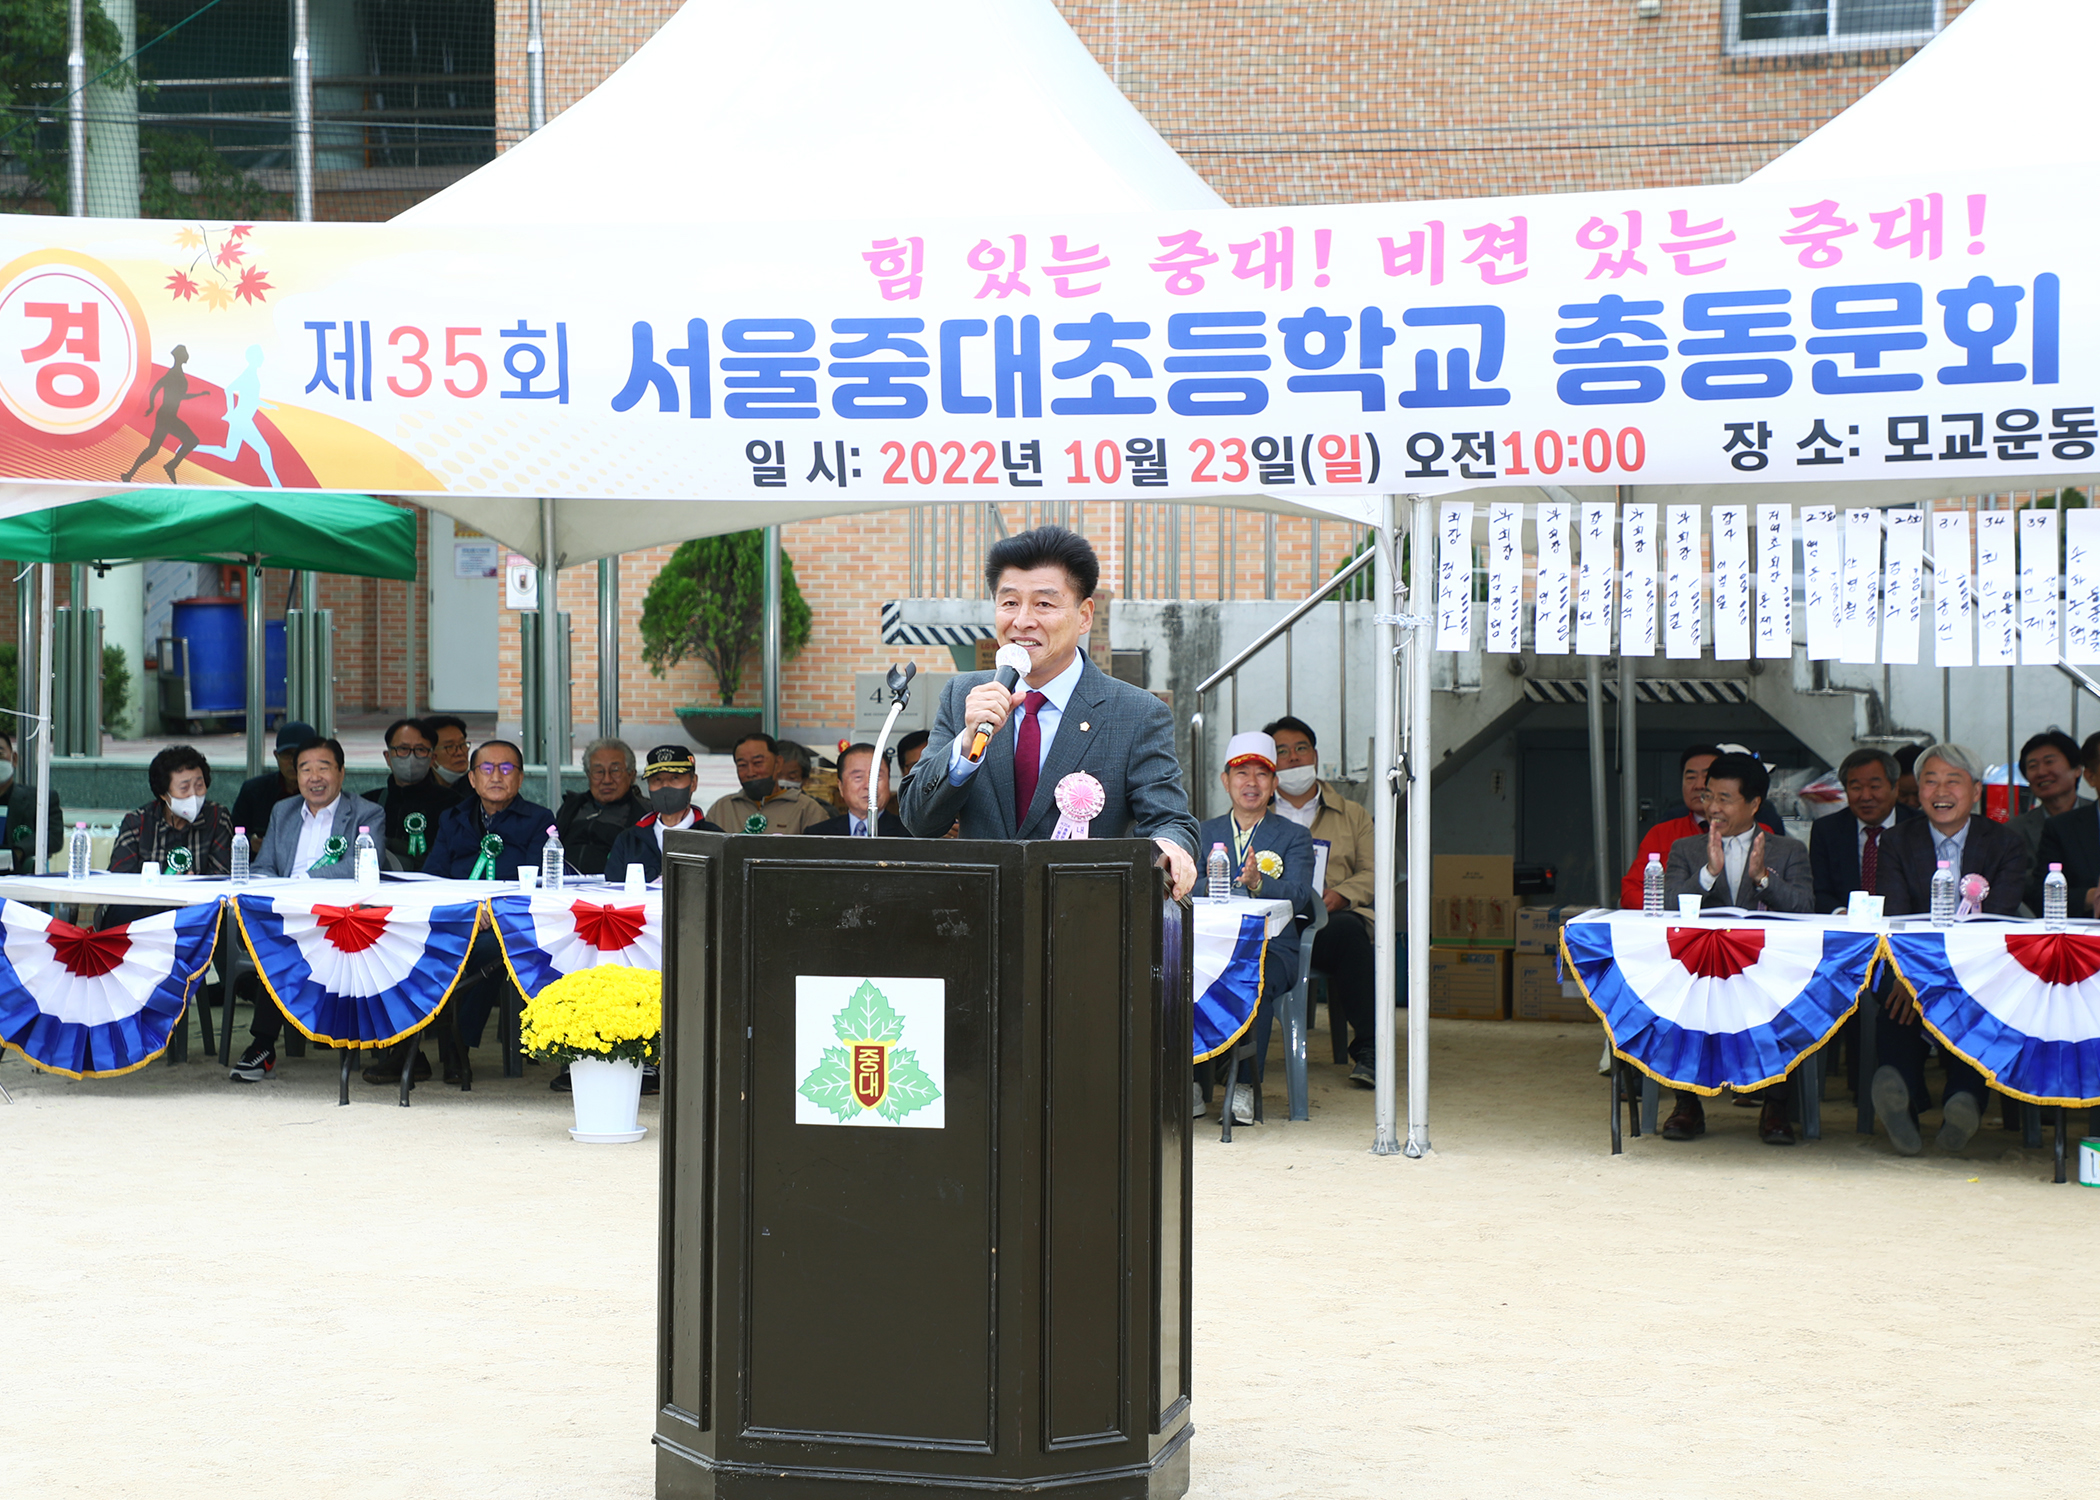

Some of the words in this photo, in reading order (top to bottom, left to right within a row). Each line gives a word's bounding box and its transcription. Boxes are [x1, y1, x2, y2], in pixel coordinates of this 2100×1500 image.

[862, 236, 924, 302] 힘
[966, 234, 1111, 300] 있는
[1149, 226, 1332, 296] 중대!
[1377, 216, 1529, 287] 비젼
[1575, 210, 1737, 280] 있는
[1779, 193, 1987, 269] 중대!
[20, 301, 101, 409] 경
[304, 319, 570, 405] 제35회
[612, 305, 1512, 419] 서울중대초등학교
[1553, 272, 2060, 406] 총동문회
[745, 440, 788, 488] 일
[806, 440, 862, 488] 시:
[880, 439, 1044, 488] 2022년
[1064, 438, 1170, 488] 10월
[1189, 432, 1381, 487] 23일(일)
[1404, 426, 1646, 480] 오전10:00
[1722, 421, 1774, 472] 장
[1795, 418, 1861, 467] 소:
[1884, 406, 2099, 462] 모교운동
[858, 1048, 880, 1098] 중대
